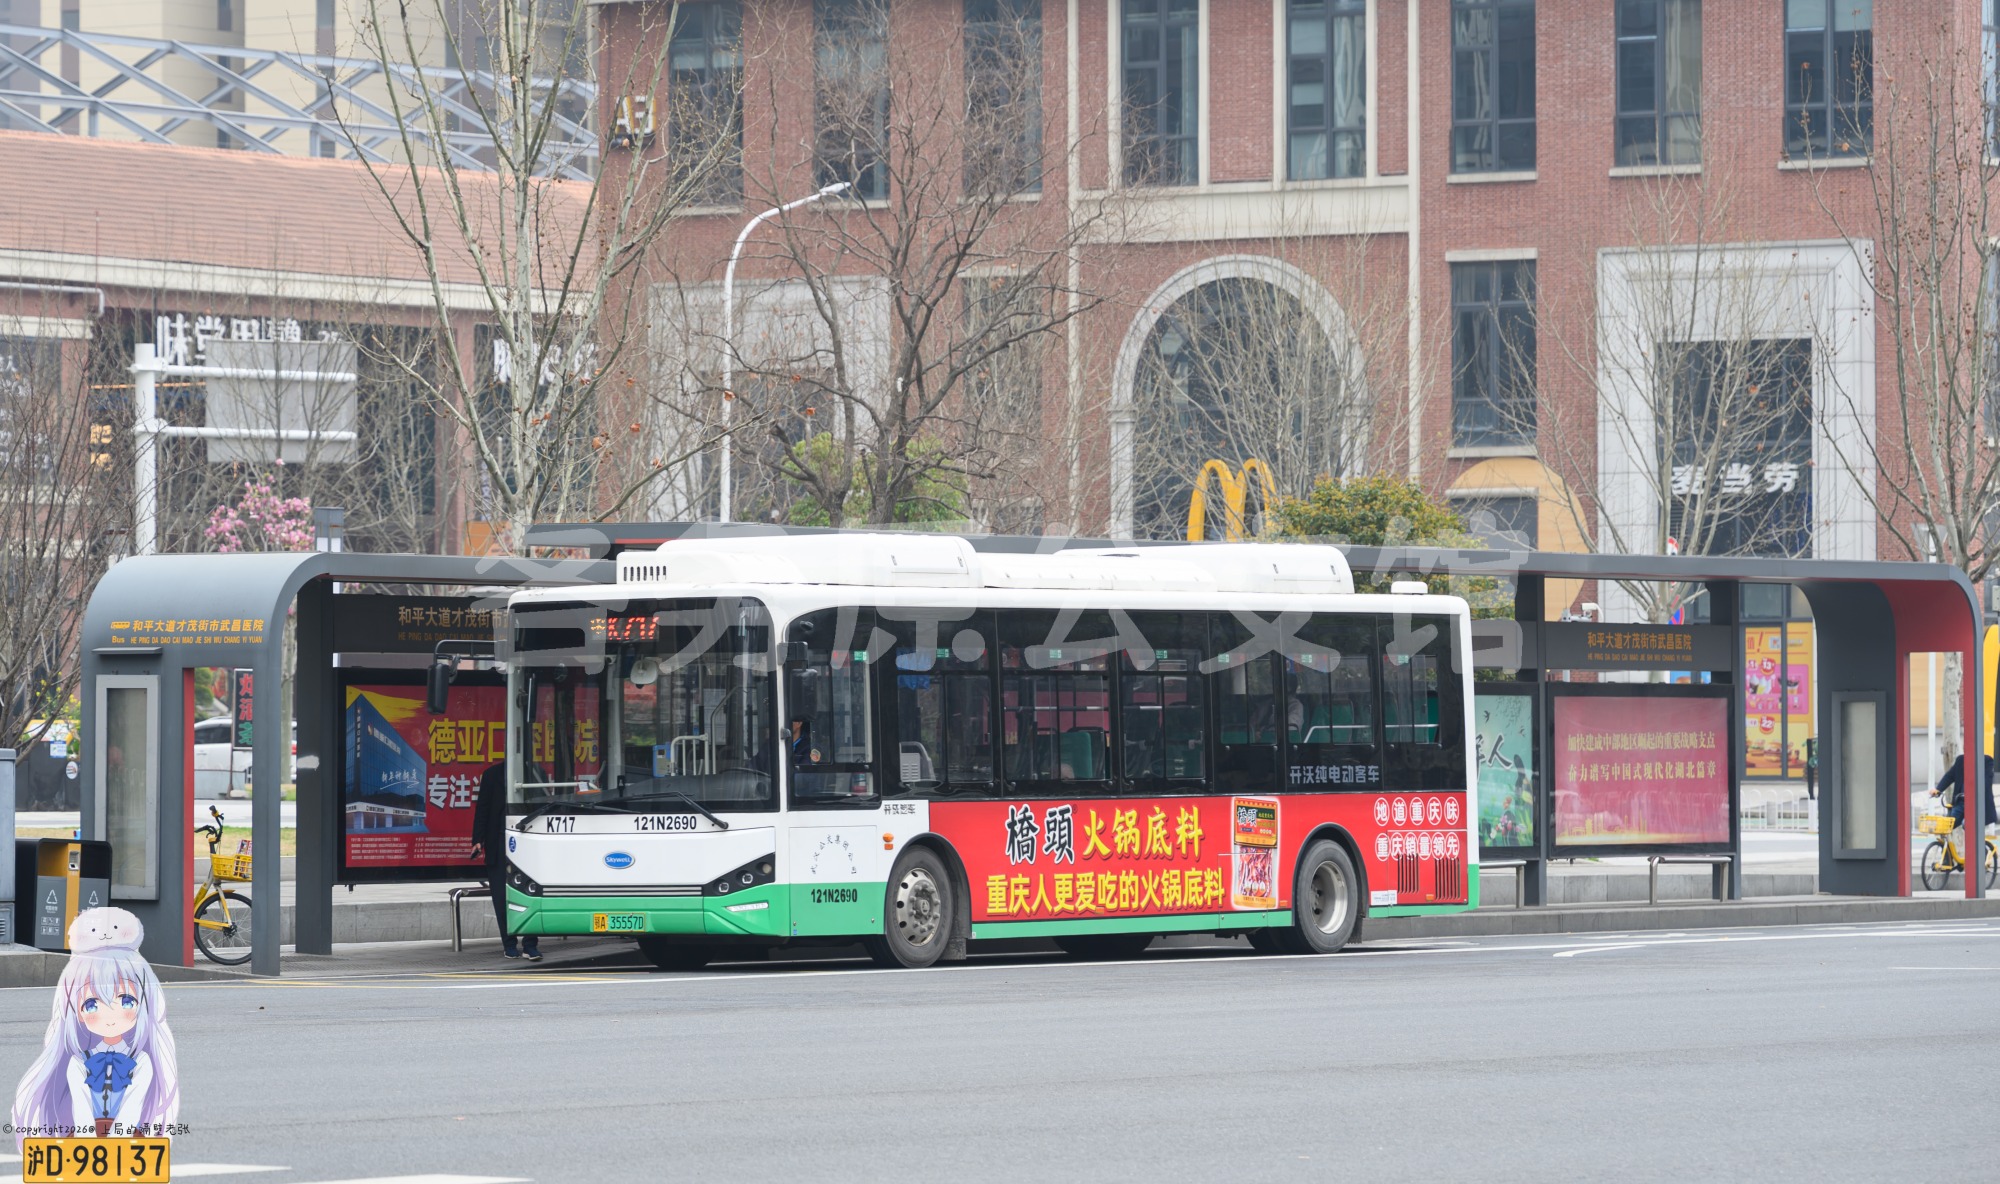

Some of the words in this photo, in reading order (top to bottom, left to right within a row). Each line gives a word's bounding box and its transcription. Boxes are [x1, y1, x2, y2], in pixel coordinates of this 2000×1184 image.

[1671, 462, 1799, 494] 麦当劳
[133, 619, 264, 632] 和平大道才茂街市武昌医院
[1588, 632, 1692, 650] 和平大道才茂街市武昌医院
[1290, 765, 1379, 784] 开沃纯电动客车
[1569, 760, 1716, 782] 奋力谱写中国式现代化湖北篇章
[1376, 801, 1458, 821] 地道重庆味
[546, 817, 576, 833] K717
[634, 816, 697, 831] 121N2690
[1005, 803, 1075, 865] 橋頭
[1083, 806, 1203, 857] 火锅底料
[1376, 836, 1459, 857] 重庆销量领先
[811, 888, 858, 903] 121N2690
[986, 867, 1225, 914] 重庆人更爱吃的火锅底料
